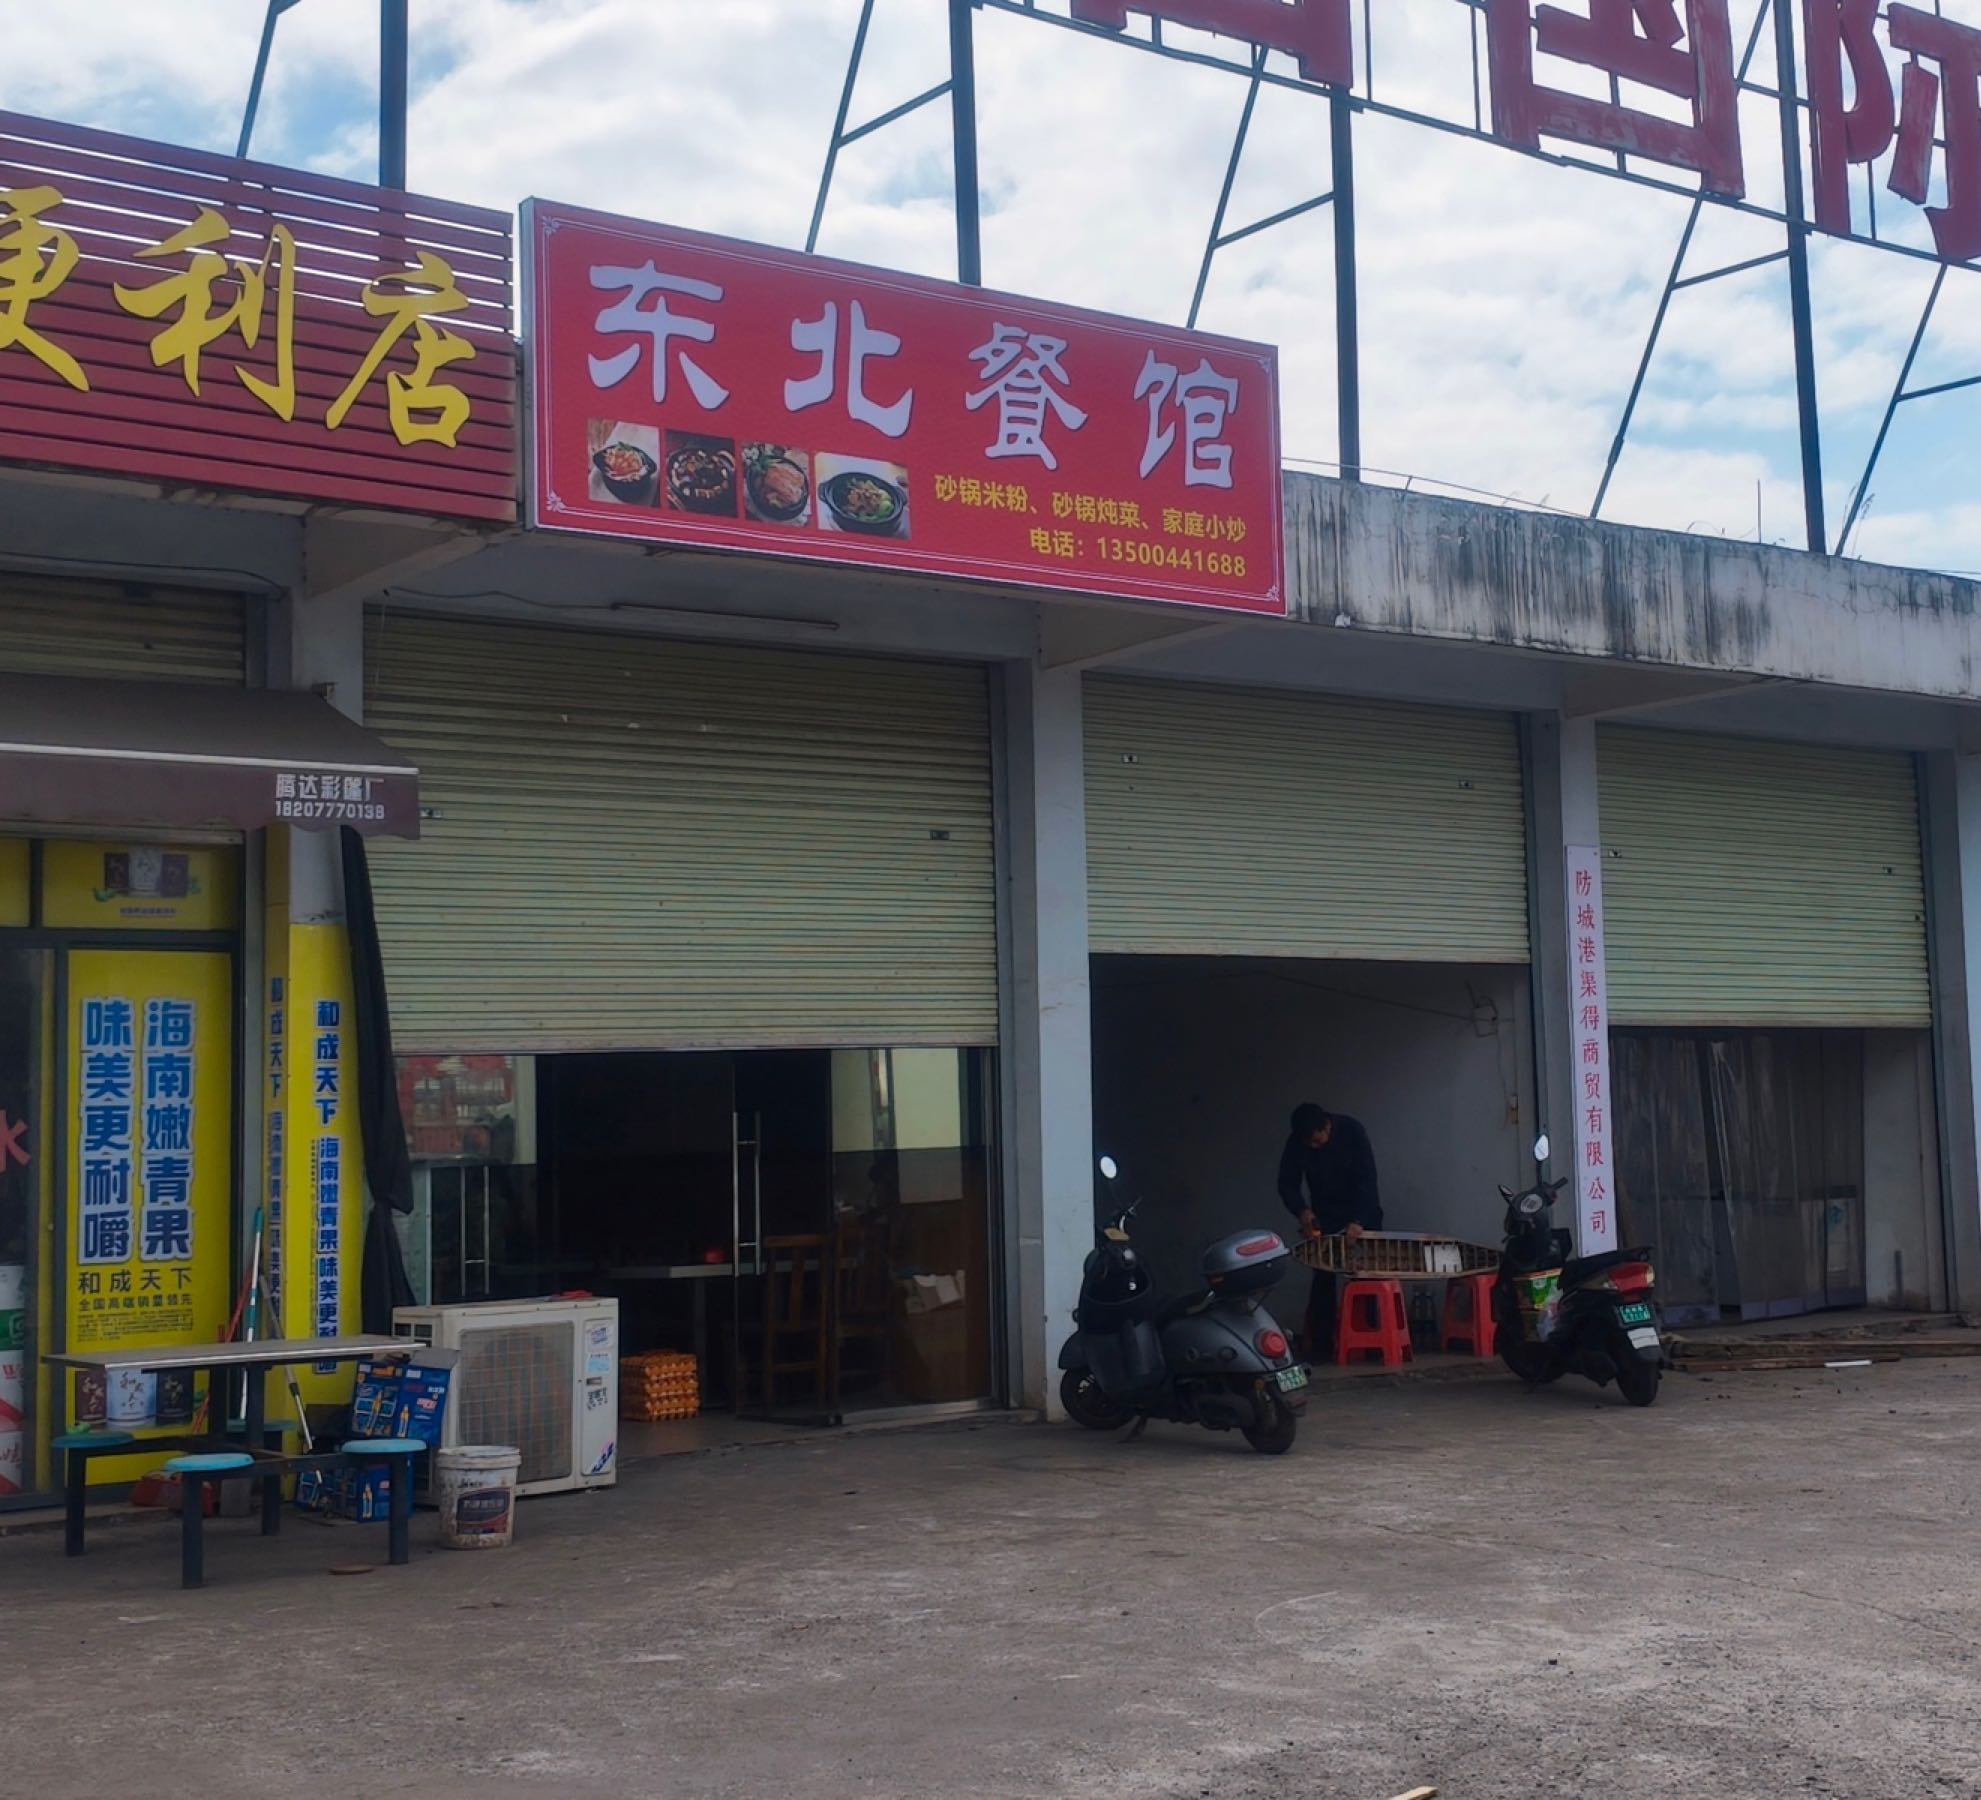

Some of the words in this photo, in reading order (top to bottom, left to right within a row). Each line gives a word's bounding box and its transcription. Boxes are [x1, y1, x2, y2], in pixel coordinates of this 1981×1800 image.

[587, 259, 1239, 489] 东北餐馆
[84, 1000, 131, 1258] 味美更耐嚼
[146, 1000, 191, 1255] 海南嫩青果
[316, 1001, 340, 1124] 和成天下
[79, 1266, 192, 1295] 和成天下
